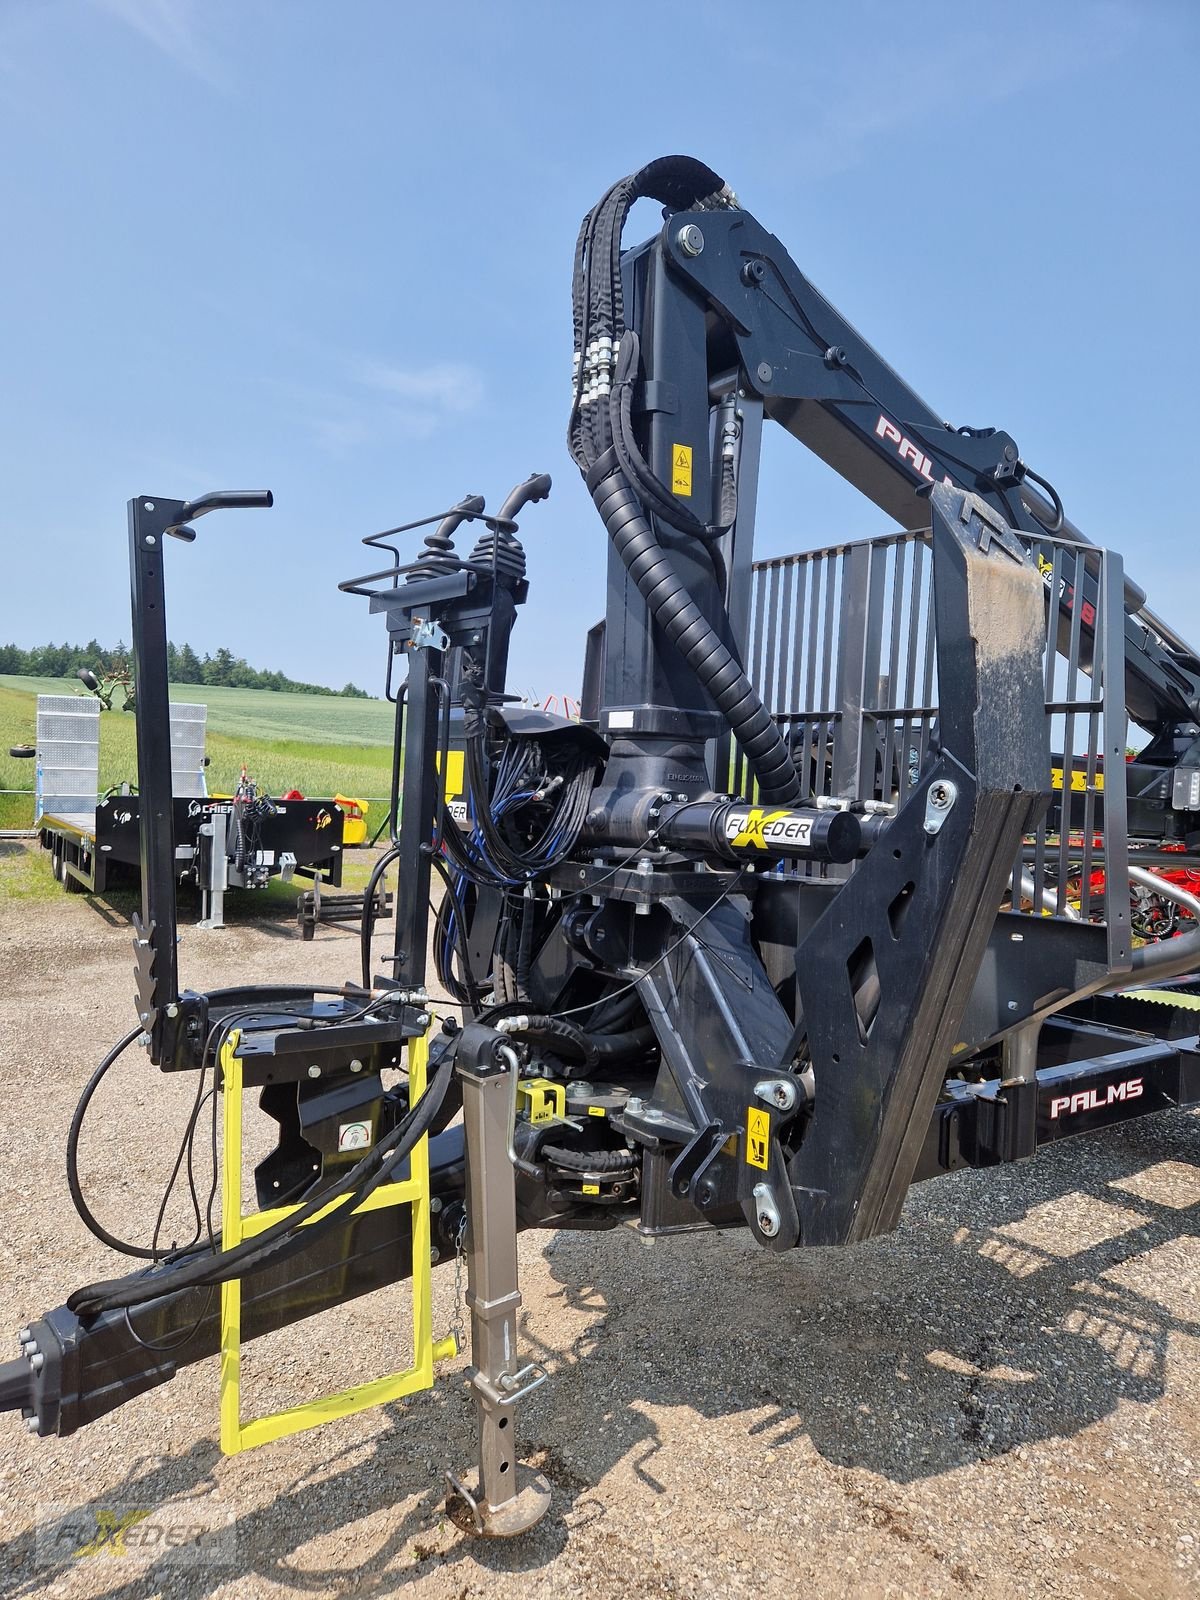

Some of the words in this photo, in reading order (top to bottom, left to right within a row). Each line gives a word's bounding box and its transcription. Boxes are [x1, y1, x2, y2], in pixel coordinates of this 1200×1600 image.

[875, 414, 953, 487] PAL
[727, 815, 811, 842] FUXEDER
[1050, 1078, 1145, 1119] PALMS
